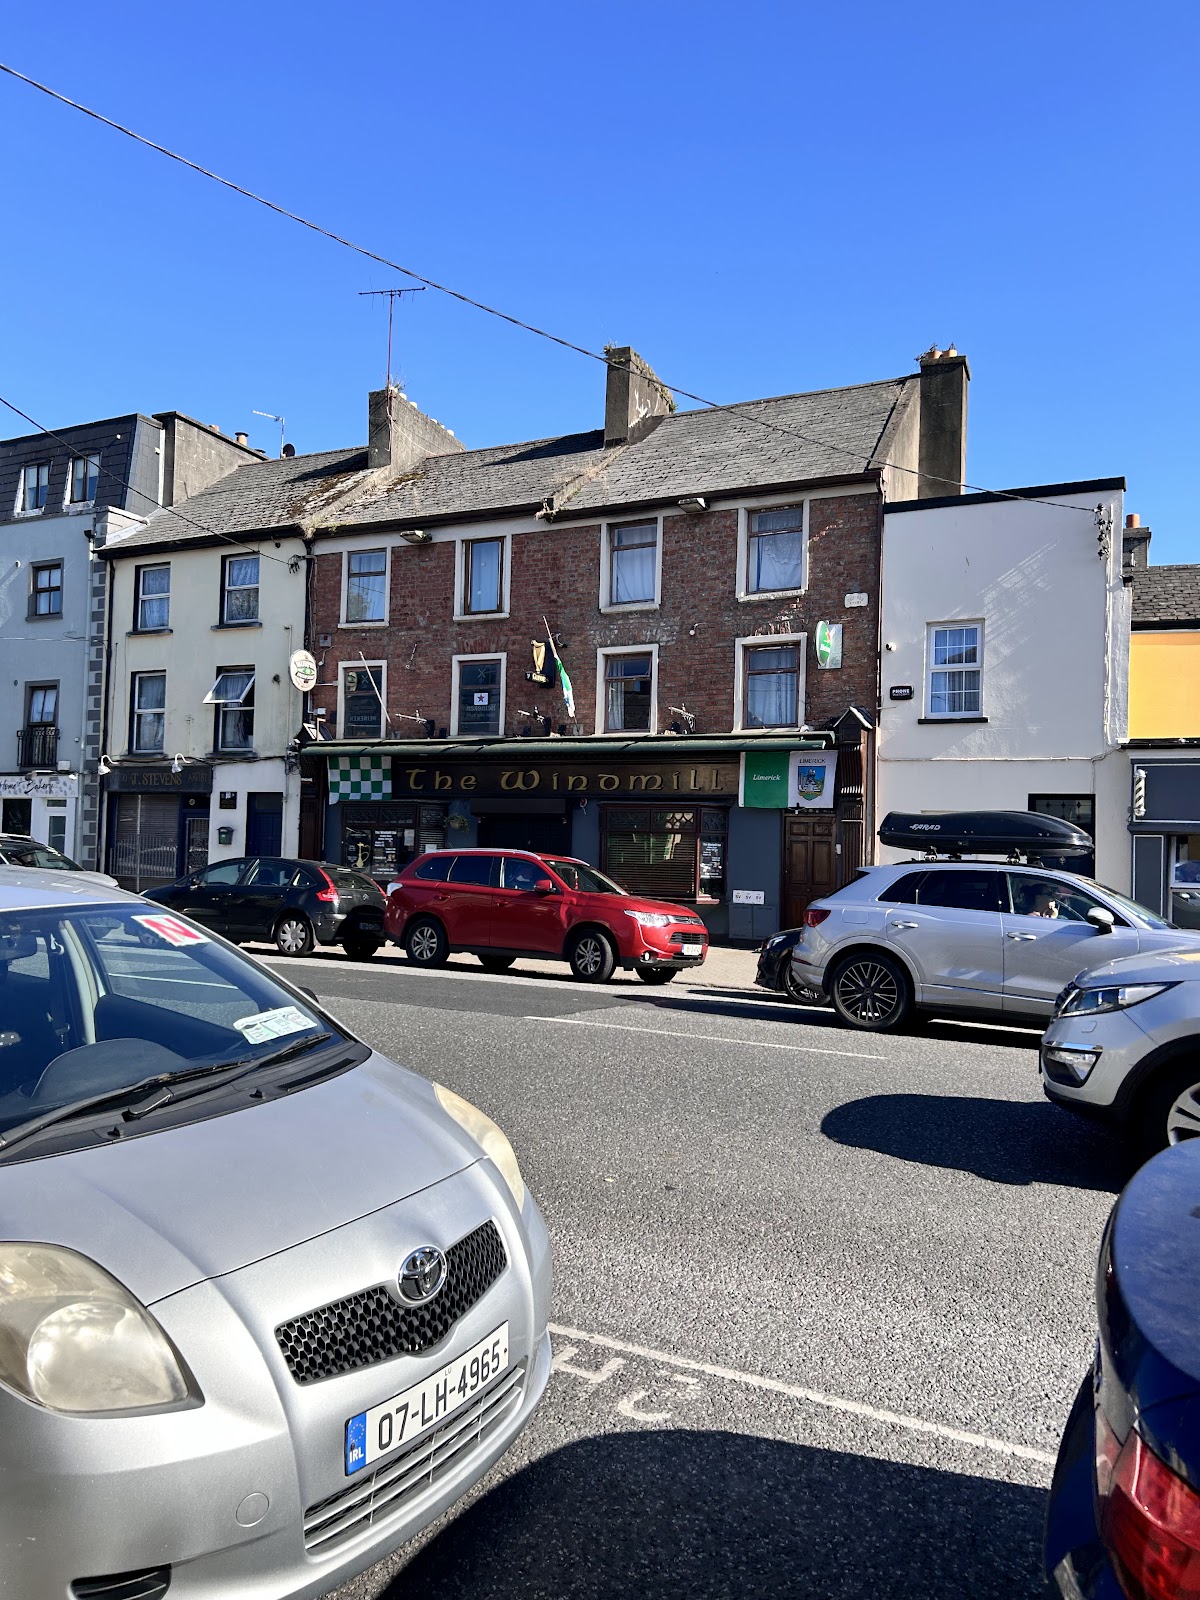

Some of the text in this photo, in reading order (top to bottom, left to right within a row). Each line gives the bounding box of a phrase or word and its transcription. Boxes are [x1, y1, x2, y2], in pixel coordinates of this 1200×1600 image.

[19, 778, 53, 794] Bakery
[142, 773, 183, 785] STEVENS
[405, 768, 723, 791] The Windmill
[143, 918, 202, 942] N
[378, 1338, 500, 1451] 07-LH-4965
[350, 1447, 364, 1464] IRL
